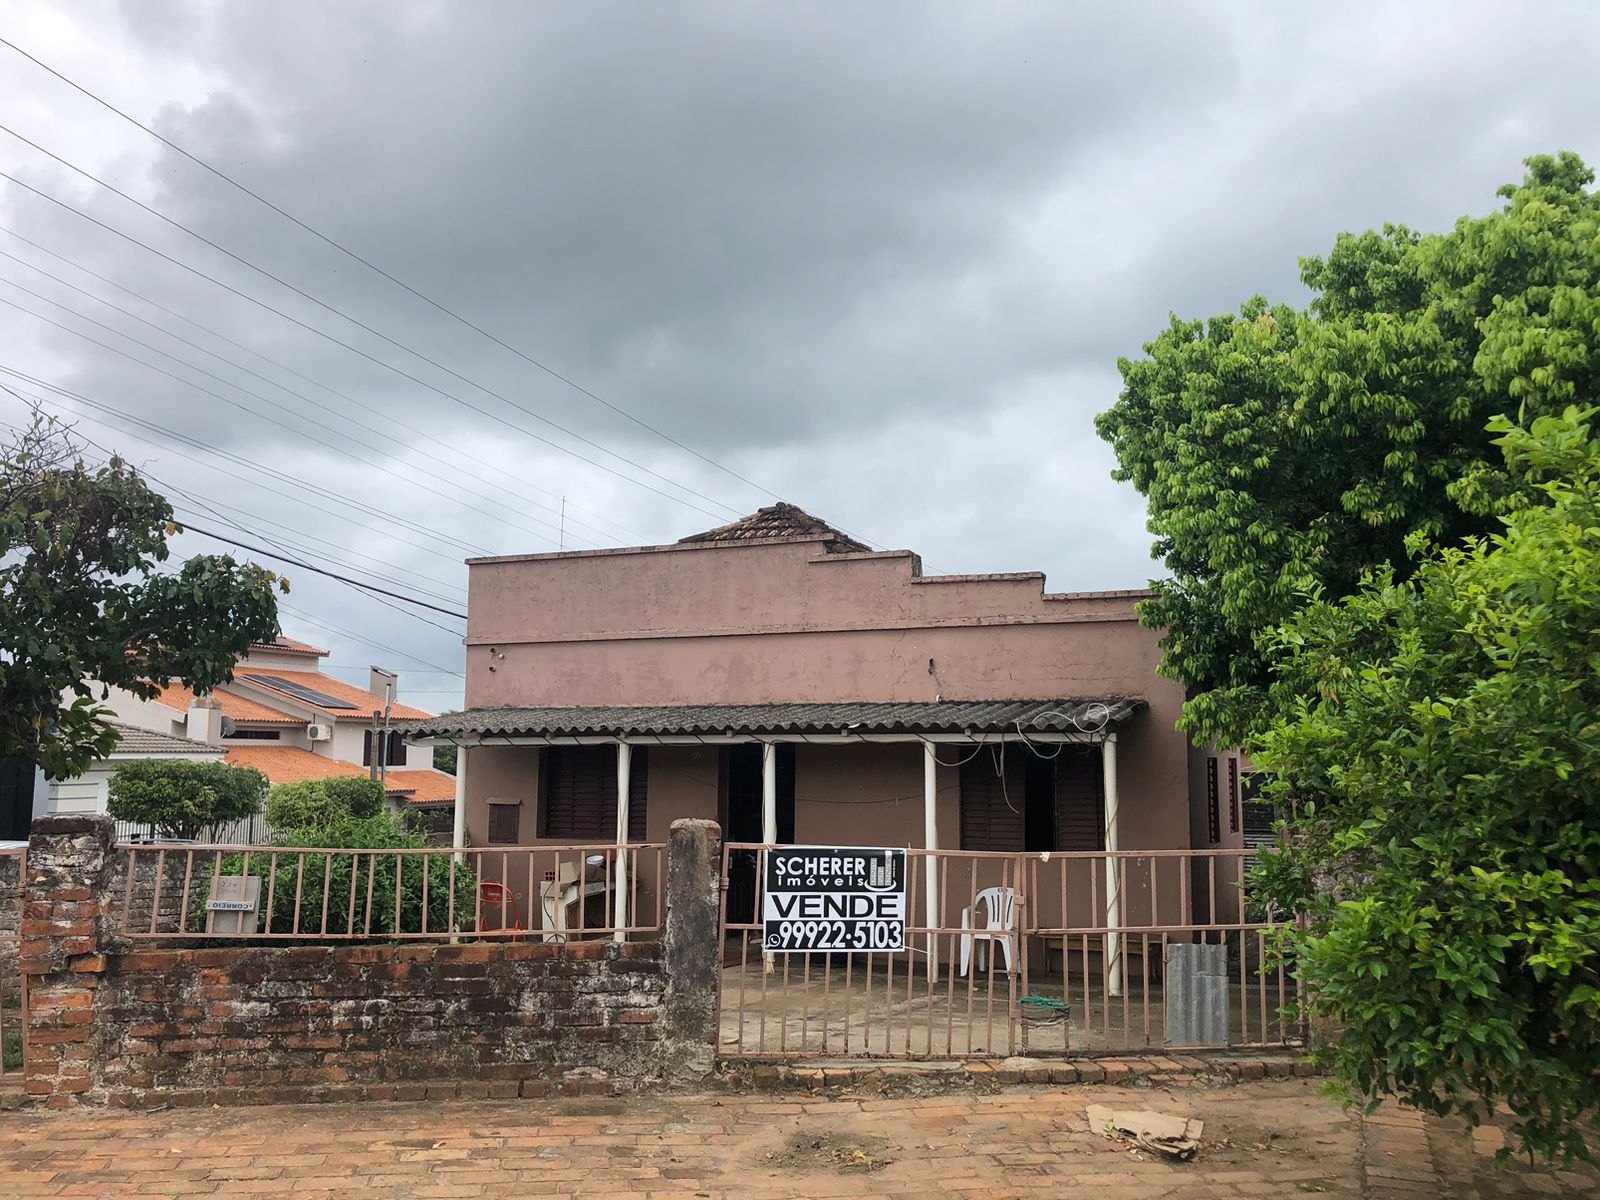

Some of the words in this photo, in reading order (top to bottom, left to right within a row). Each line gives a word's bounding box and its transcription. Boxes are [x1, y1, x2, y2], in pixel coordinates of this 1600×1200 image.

[775, 856, 866, 876] SCHERER
[777, 875, 864, 886] imóveis
[771, 894, 899, 918] VENDE
